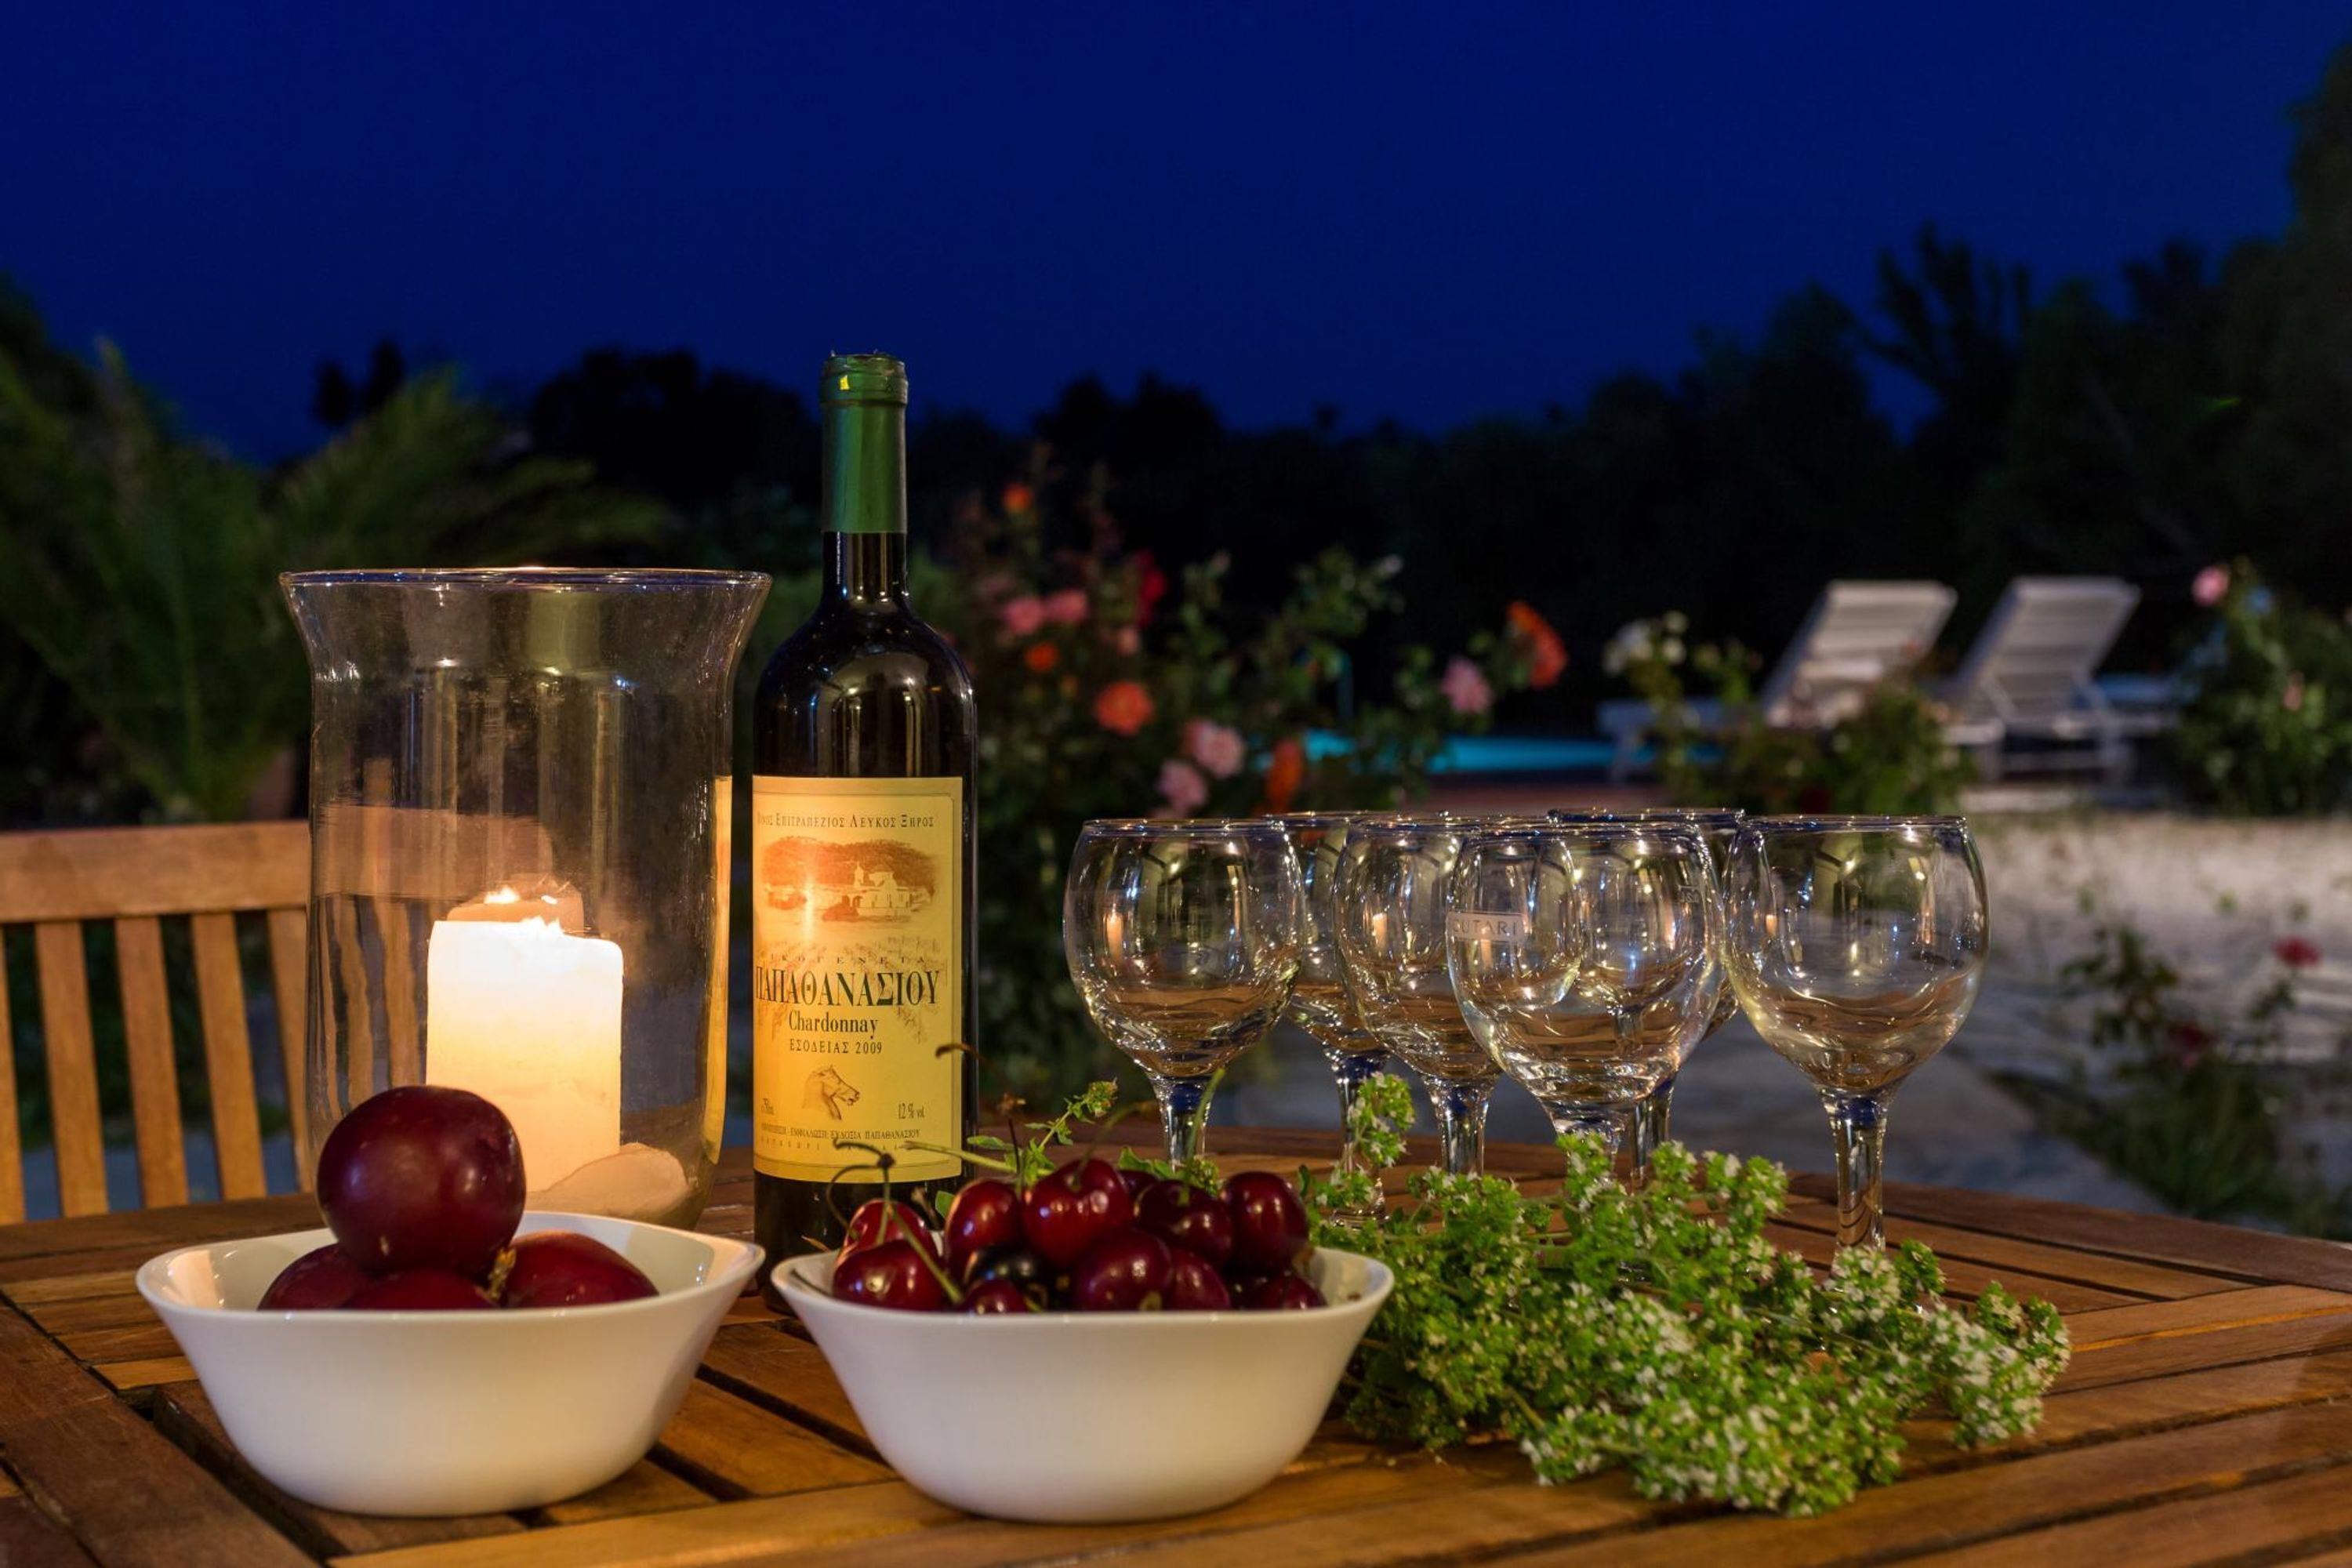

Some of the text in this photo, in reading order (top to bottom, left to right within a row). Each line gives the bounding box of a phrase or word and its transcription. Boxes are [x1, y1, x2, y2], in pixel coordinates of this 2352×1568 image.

[850, 814, 896, 828] ΛΕΥΚΟΣ
[900, 814, 935, 828] ΞΗΡΟΣ
[756, 966, 940, 1007] ΠΑΠΑΘΑΝΑΣΙΟΥ
[789, 1009, 880, 1039] Chardonnay
[789, 1038, 883, 1054] ΕΣΟΔΕΙΑΣ 2009
